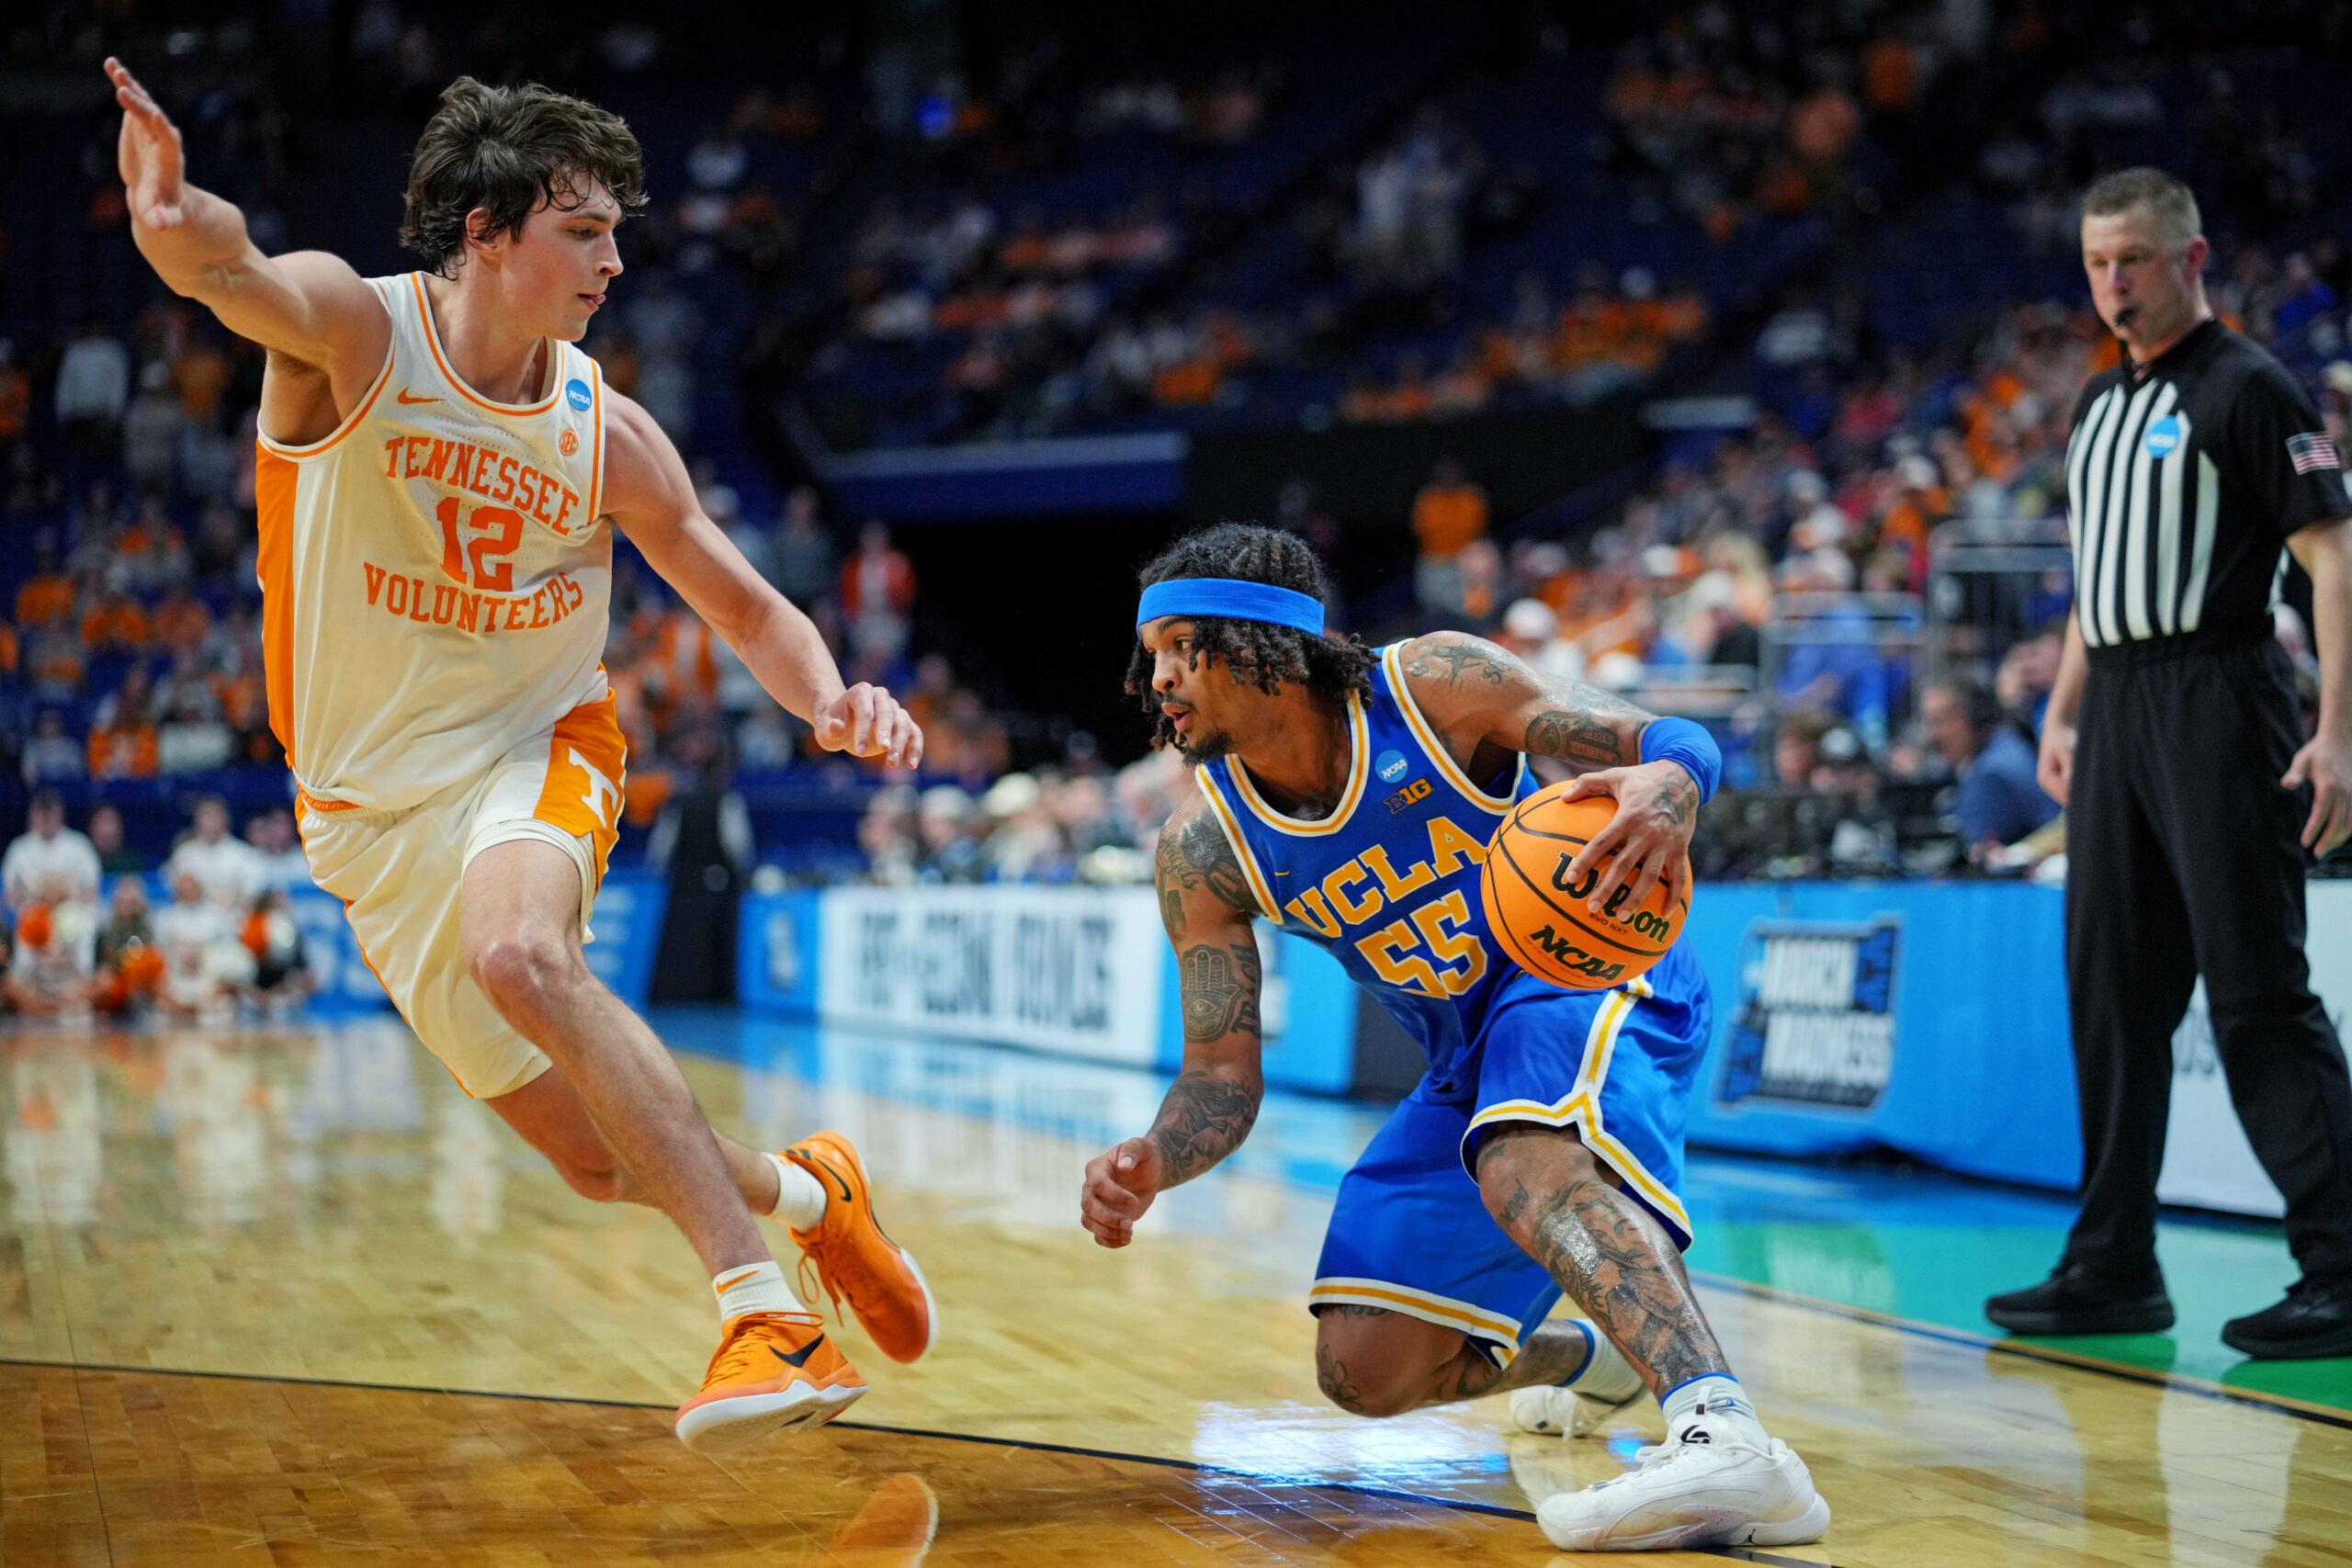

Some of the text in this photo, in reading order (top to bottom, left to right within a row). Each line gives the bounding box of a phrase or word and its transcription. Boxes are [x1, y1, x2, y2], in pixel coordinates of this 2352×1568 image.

[569, 389, 591, 406] NCAA
[560, 431, 579, 454] SEC
[385, 435, 580, 536] TENNESSEE
[436, 496, 524, 592] 12
[364, 561, 583, 633] VOLUNTEERS
[1381, 759, 1408, 779] NCAA
[1284, 816, 1489, 938] UCLA
[1551, 851, 1670, 943] Wlon
[1353, 888, 1488, 999] 55
[1529, 924, 1626, 980] NCAA
[1589, 912, 1630, 935] EVO NXT
